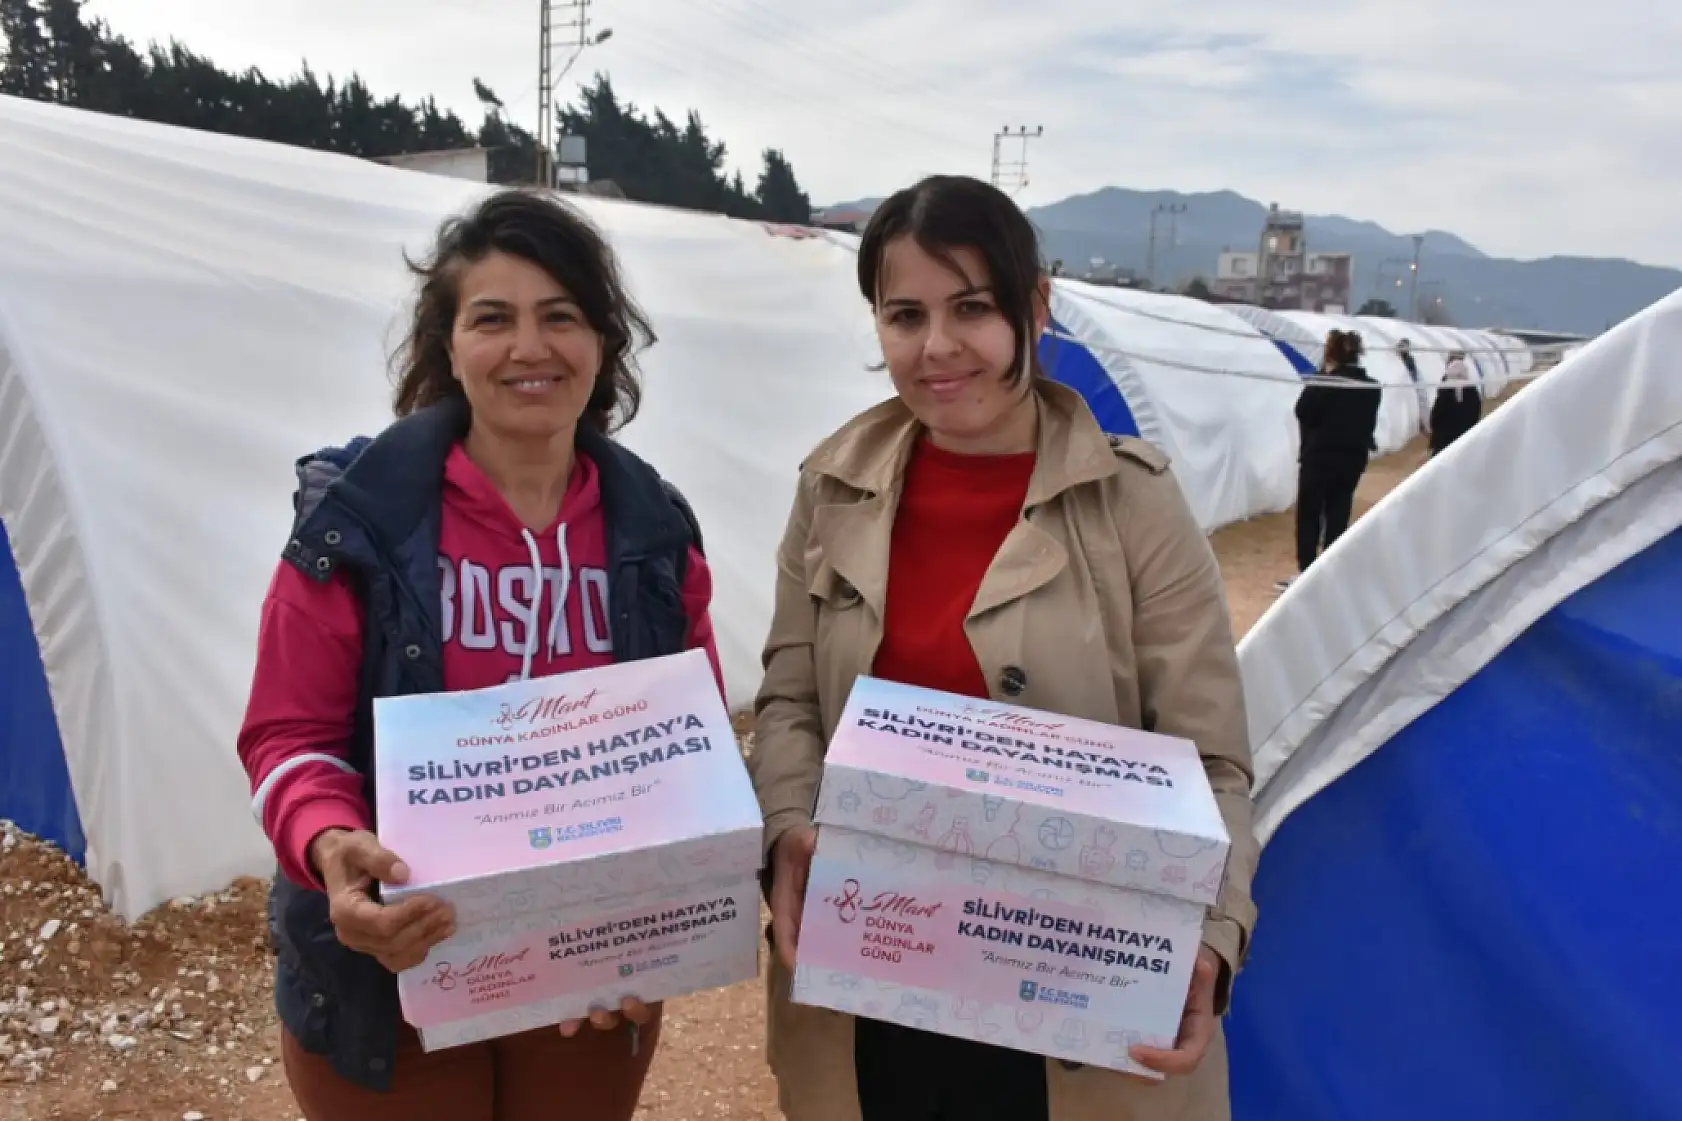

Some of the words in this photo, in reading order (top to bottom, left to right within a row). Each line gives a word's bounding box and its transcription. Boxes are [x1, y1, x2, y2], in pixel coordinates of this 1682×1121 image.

[456, 733, 515, 748] DÜNYA
[518, 716, 600, 742] KADINLAR
[602, 699, 648, 721] GÜNÜ
[513, 688, 602, 724] Mart
[408, 745, 582, 781] SİLİVRİ'DEN
[587, 714, 704, 756] HATAY'A
[857, 718, 954, 746] KADIN
[961, 739, 1174, 788] DAYANIŞMASI
[863, 708, 1036, 750] SİLİVRİ'DEN
[1043, 744, 1169, 775] HATAY'A
[408, 782, 506, 805] KADIN
[512, 736, 712, 795] DAYANIŞMASI
[544, 802, 566, 815] Bir
[548, 914, 657, 947] SİLİVRİ'DEN
[661, 896, 736, 922] HATAY'A
[860, 891, 943, 918] Mart
[865, 916, 914, 935] DÜNYA
[962, 897, 1084, 937] SİLİVRİ'DEN
[1087, 922, 1174, 953] HATAY'A
[550, 938, 609, 961] KADIN
[612, 909, 738, 947] DAYANIŞMASI
[860, 946, 902, 963] GÜNÜ
[862, 931, 936, 954] KADINLAR
[957, 920, 1023, 946] KADIN
[1027, 934, 1171, 974] DAYANIŞMASI
[1035, 961, 1057, 976] Bir
